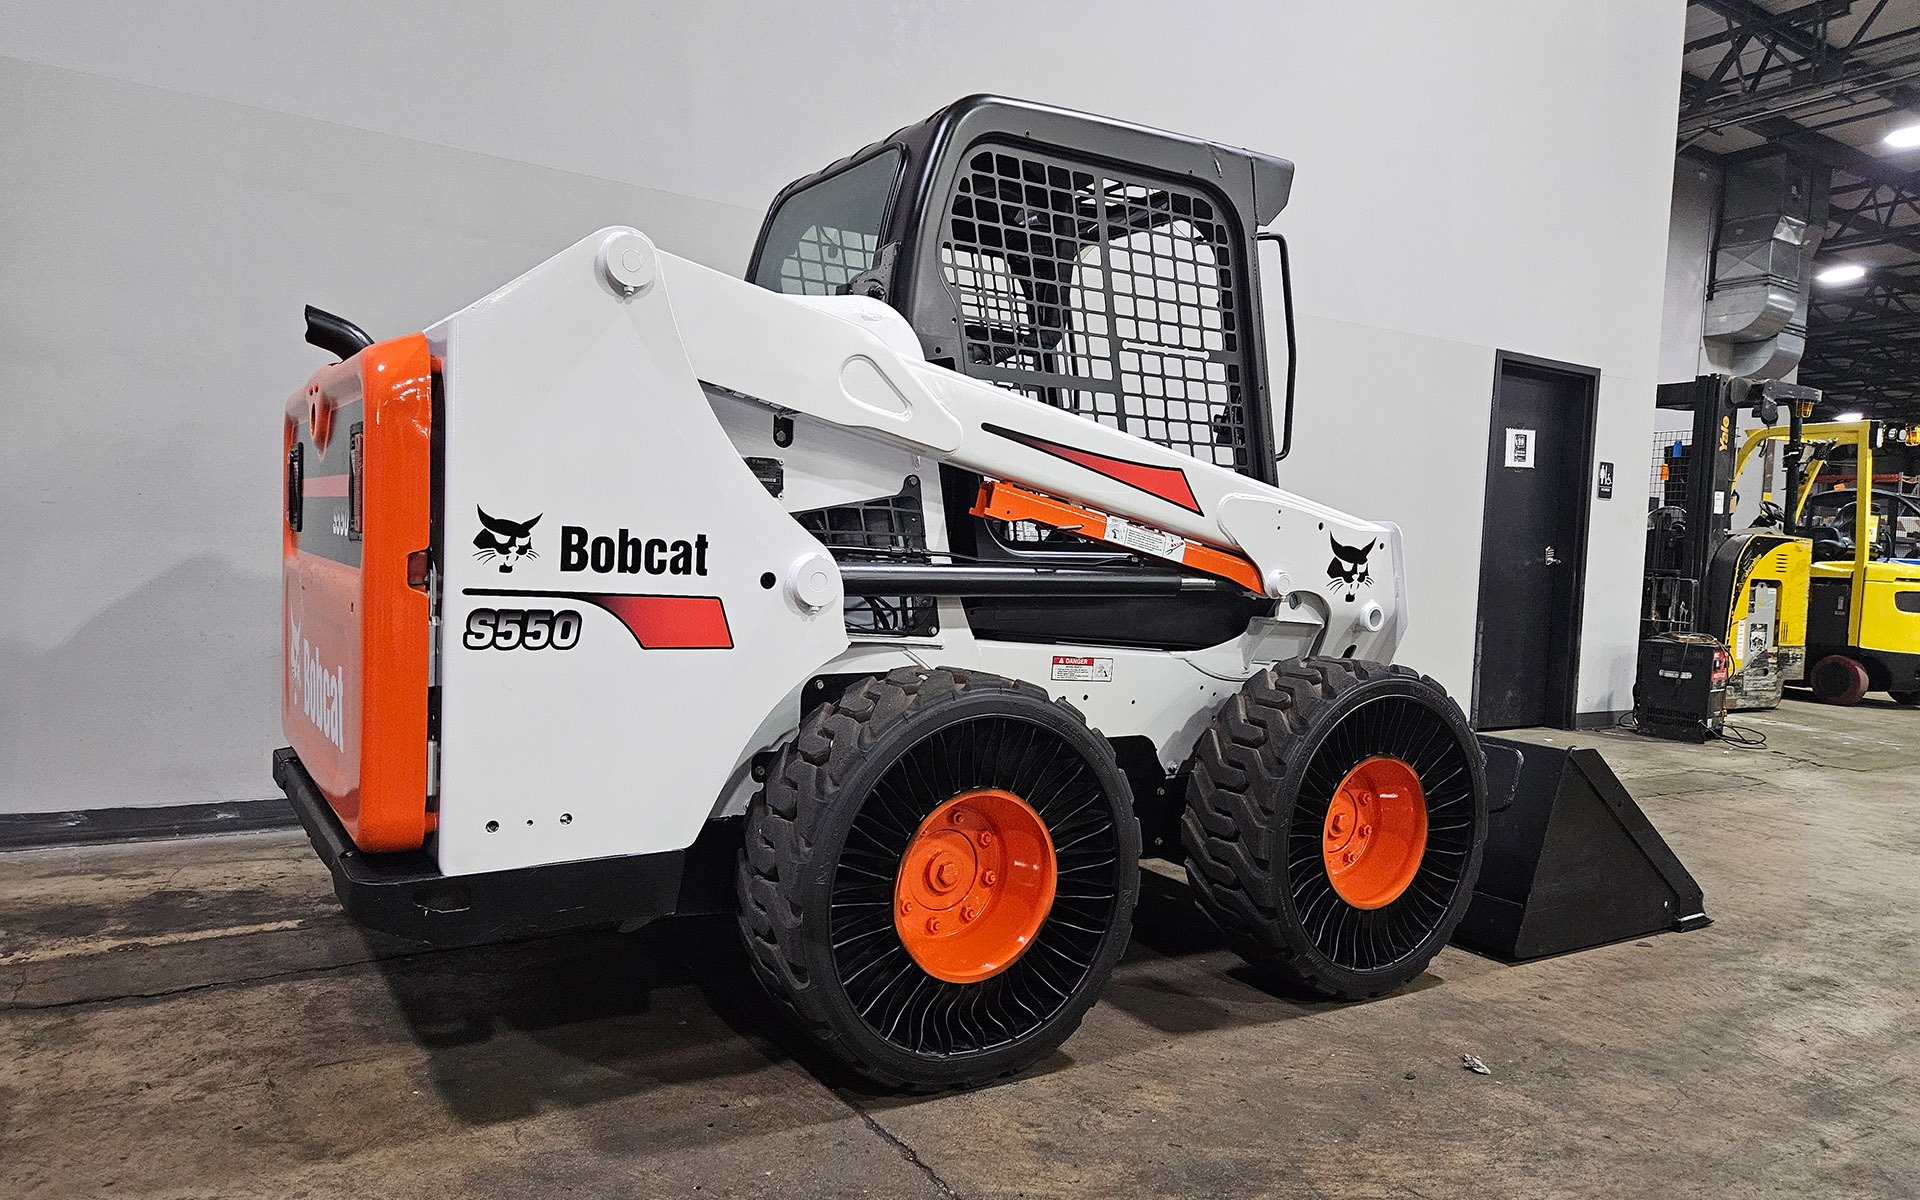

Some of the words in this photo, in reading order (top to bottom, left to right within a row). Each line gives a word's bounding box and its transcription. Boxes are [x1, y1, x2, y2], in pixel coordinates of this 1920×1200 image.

[1718, 415, 1730, 452] Yale
[560, 526, 708, 577] Bobcat
[462, 608, 583, 651] S550
[1065, 657, 1088, 665] DANGER
[302, 638, 345, 754] Bobcat
